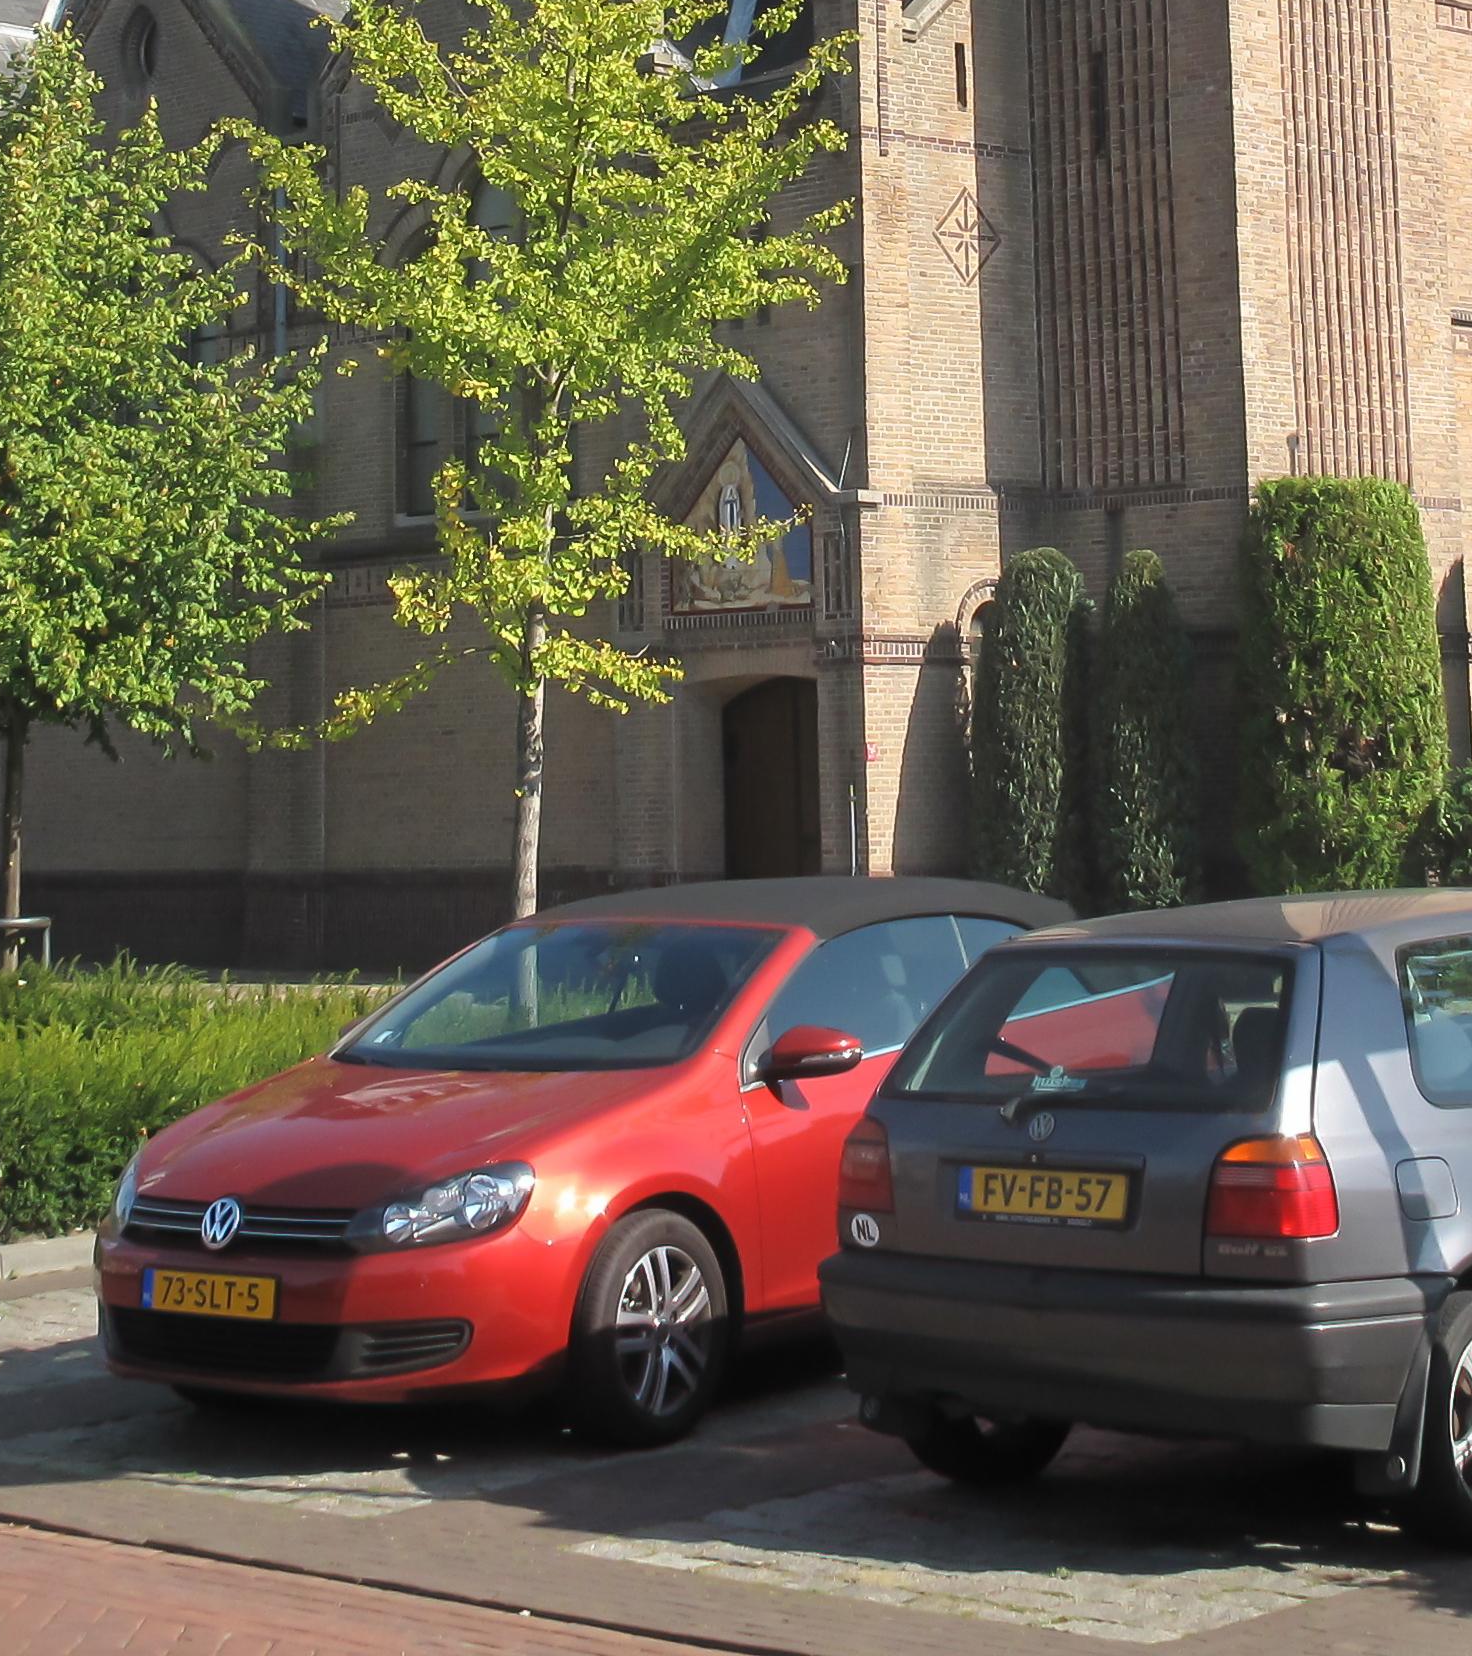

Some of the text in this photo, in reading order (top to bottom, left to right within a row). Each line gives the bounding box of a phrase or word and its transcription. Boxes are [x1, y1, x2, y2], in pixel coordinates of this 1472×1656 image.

[983, 1173, 1112, 1213] FV-FB-57
[202, 1198, 240, 1249] VW
[855, 1218, 876, 1242] NL
[162, 1275, 260, 1312] 73-SLT-5
